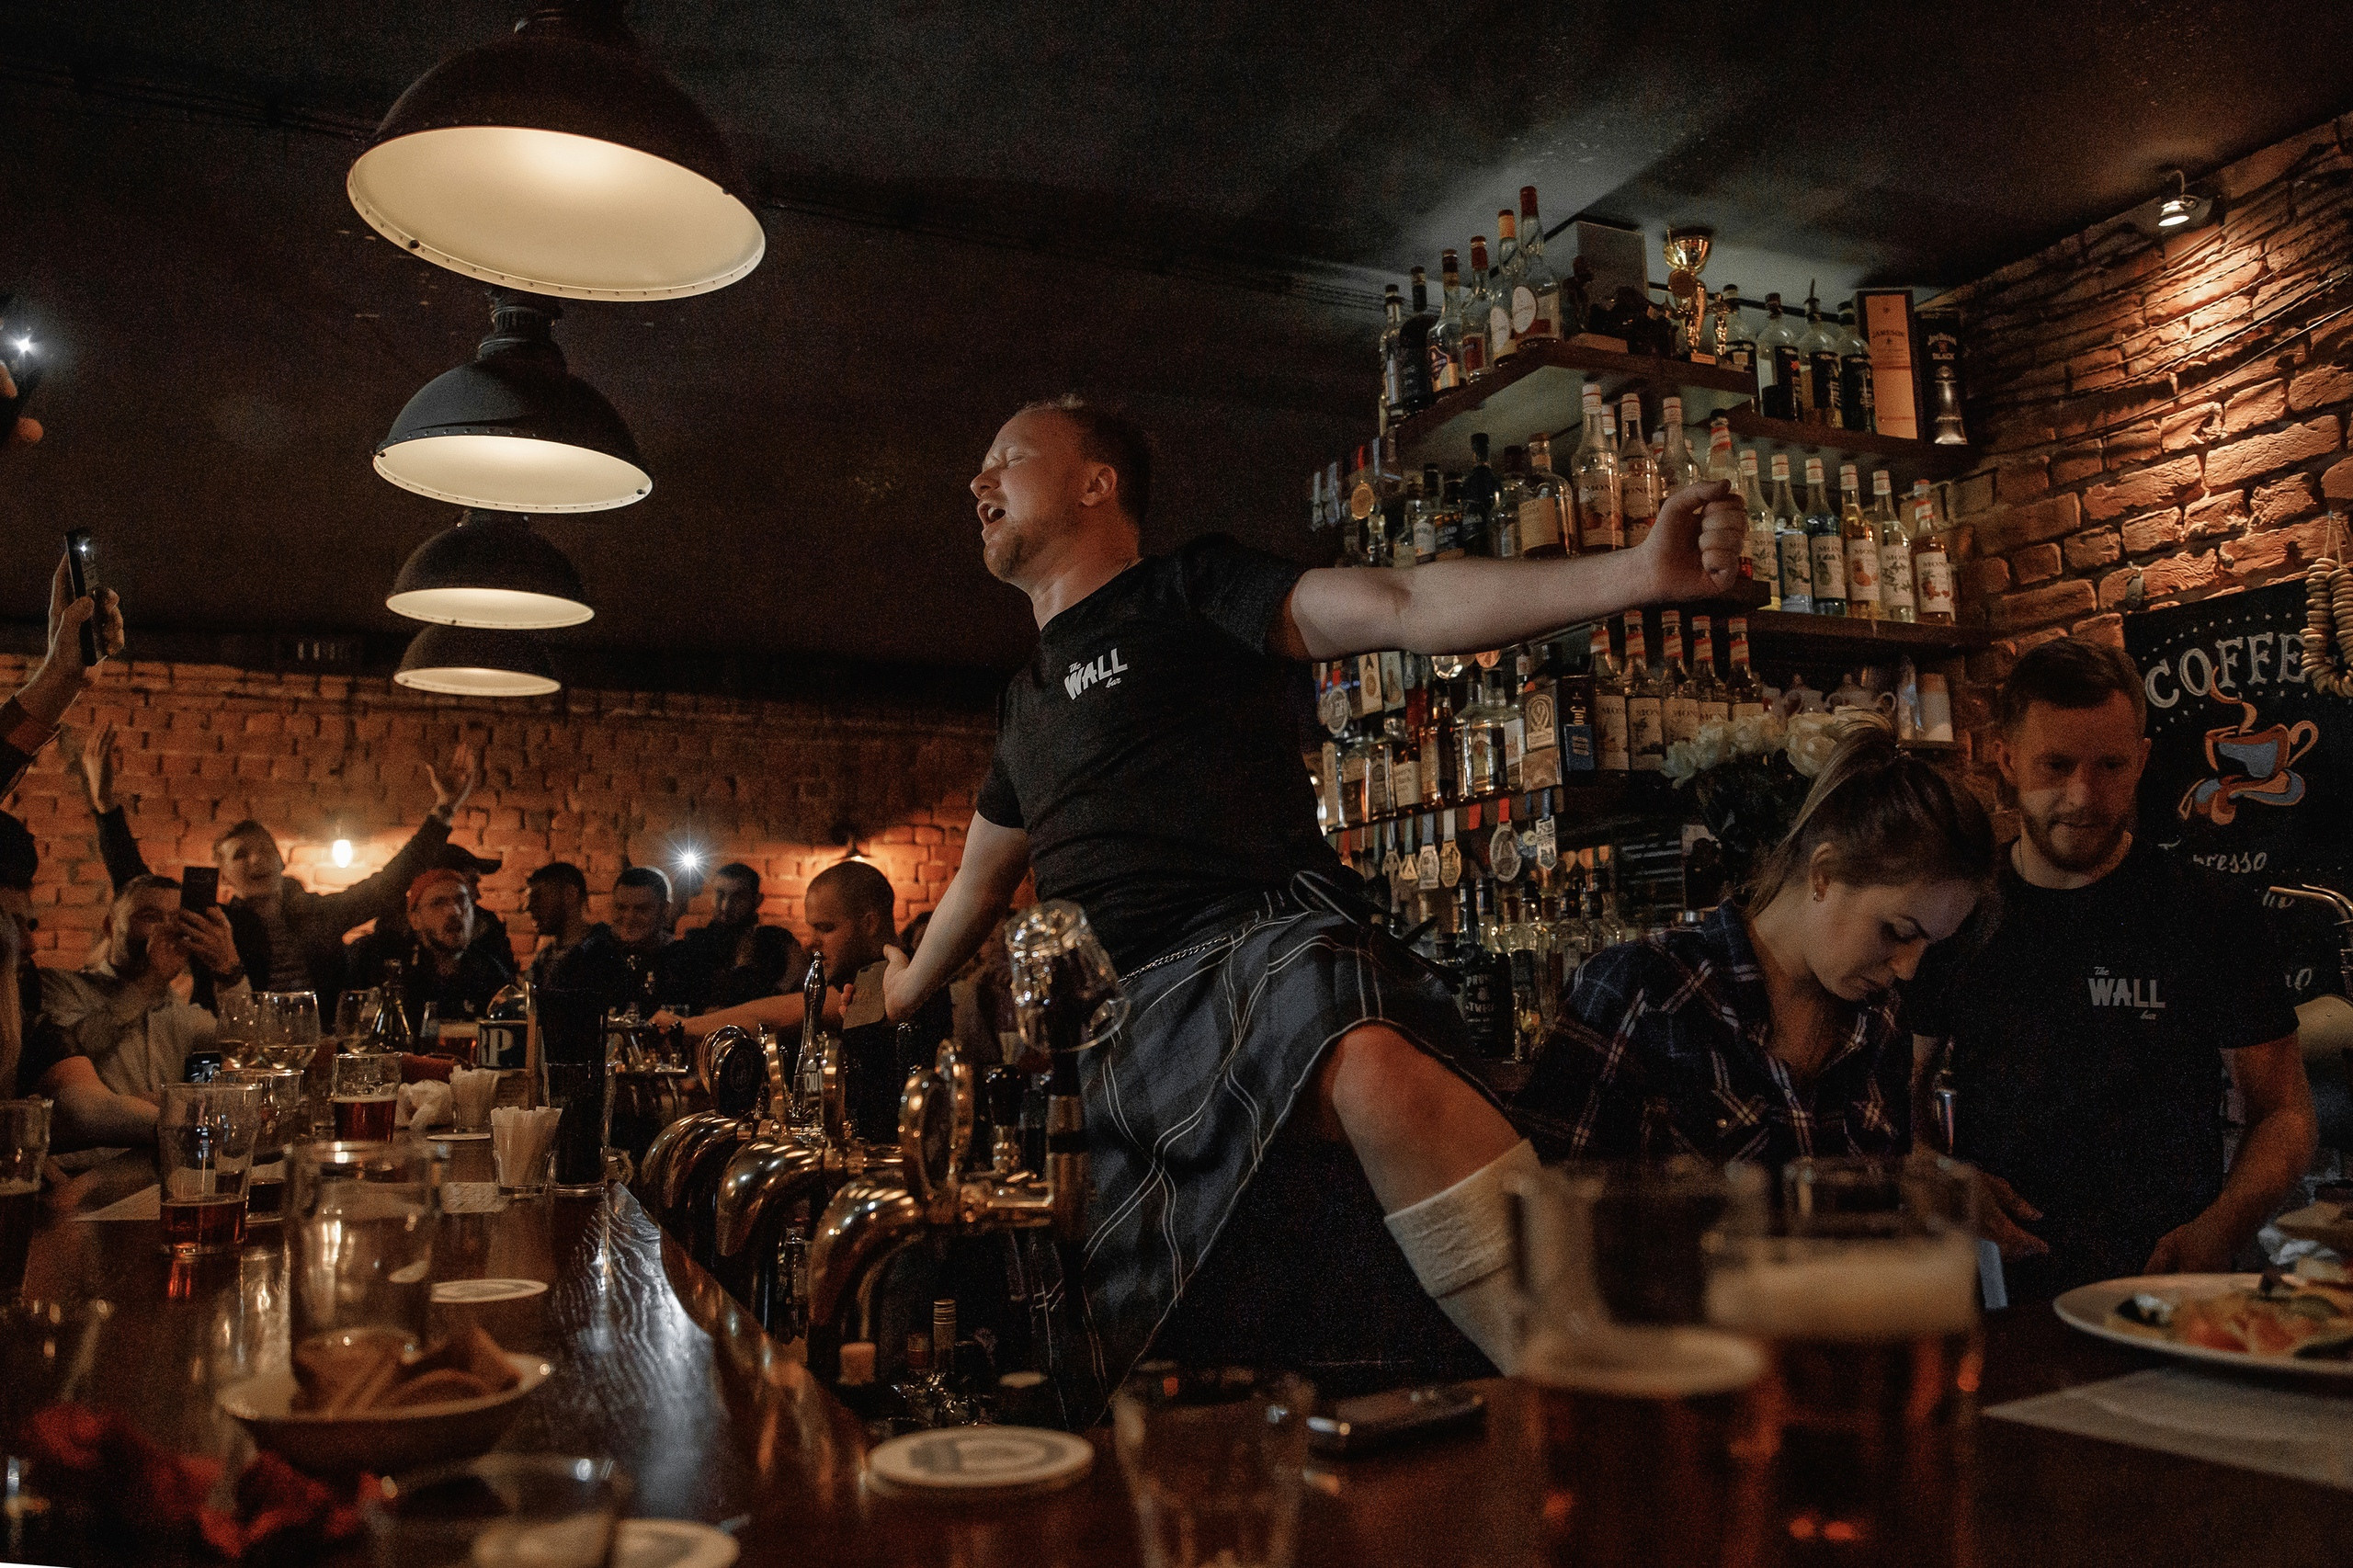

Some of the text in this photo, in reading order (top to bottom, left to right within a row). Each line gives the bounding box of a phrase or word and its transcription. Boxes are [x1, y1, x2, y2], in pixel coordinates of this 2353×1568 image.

[1063, 647, 1129, 700] WALL
[2144, 631, 2306, 710] COFFE
[2087, 977, 2166, 1009] WALL
